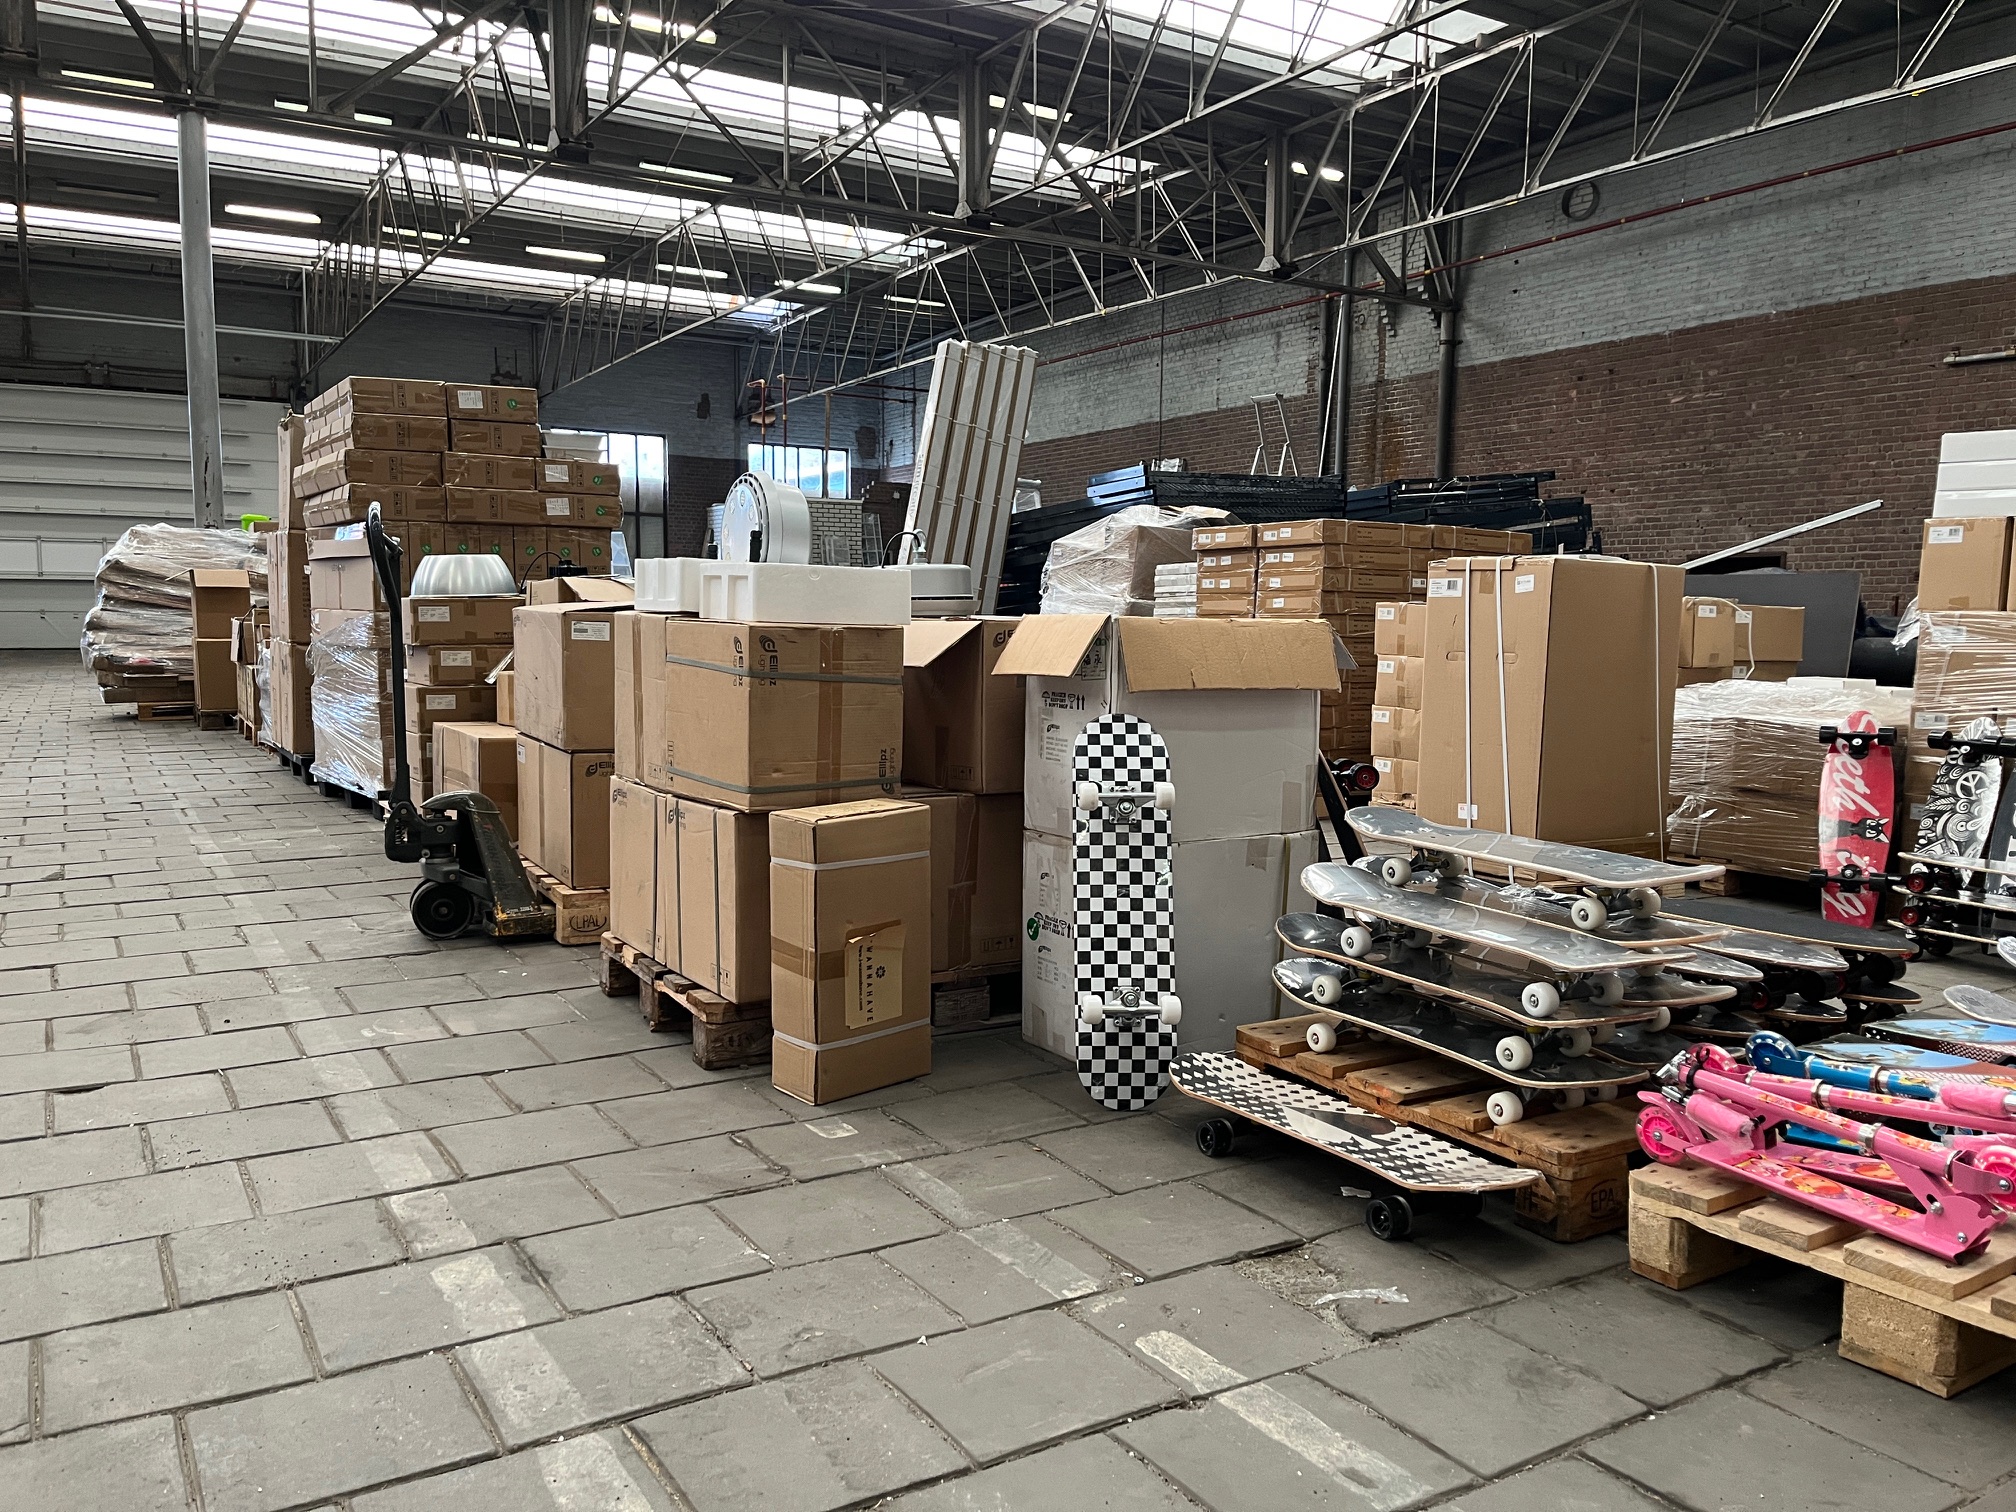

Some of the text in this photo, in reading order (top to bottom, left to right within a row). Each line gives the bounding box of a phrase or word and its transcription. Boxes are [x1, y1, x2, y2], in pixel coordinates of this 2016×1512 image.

[770, 655, 778, 687] Elliz
[598, 761, 615, 769] Ellip
[879, 748, 888, 778] Ellipz
